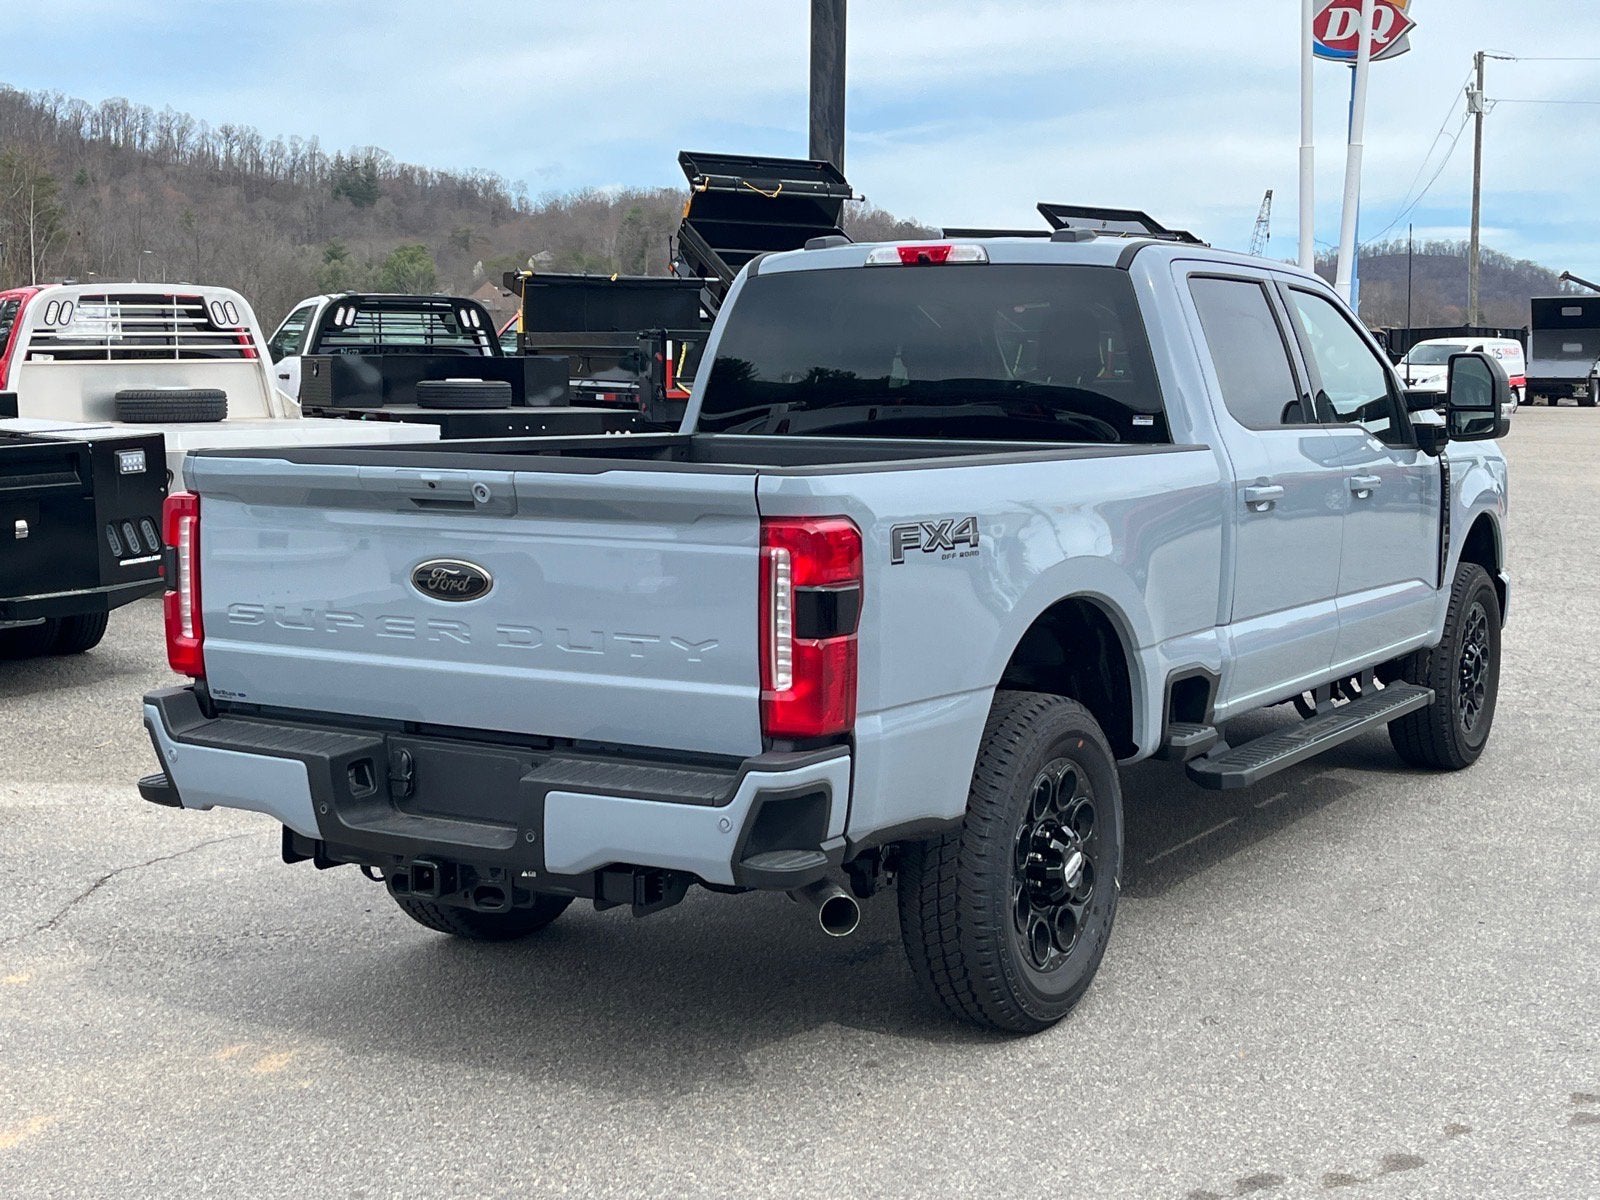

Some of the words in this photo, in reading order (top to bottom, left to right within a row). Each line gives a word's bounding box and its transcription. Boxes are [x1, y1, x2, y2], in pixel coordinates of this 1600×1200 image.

[1323, 5, 1394, 44] DQ
[890, 516, 979, 565] FX4
[941, 552, 958, 561] OFF
[959, 550, 980, 559] ROAD
[427, 567, 472, 593] Ford
[228, 602, 472, 645] SUPER
[496, 622, 720, 663] DUTY
